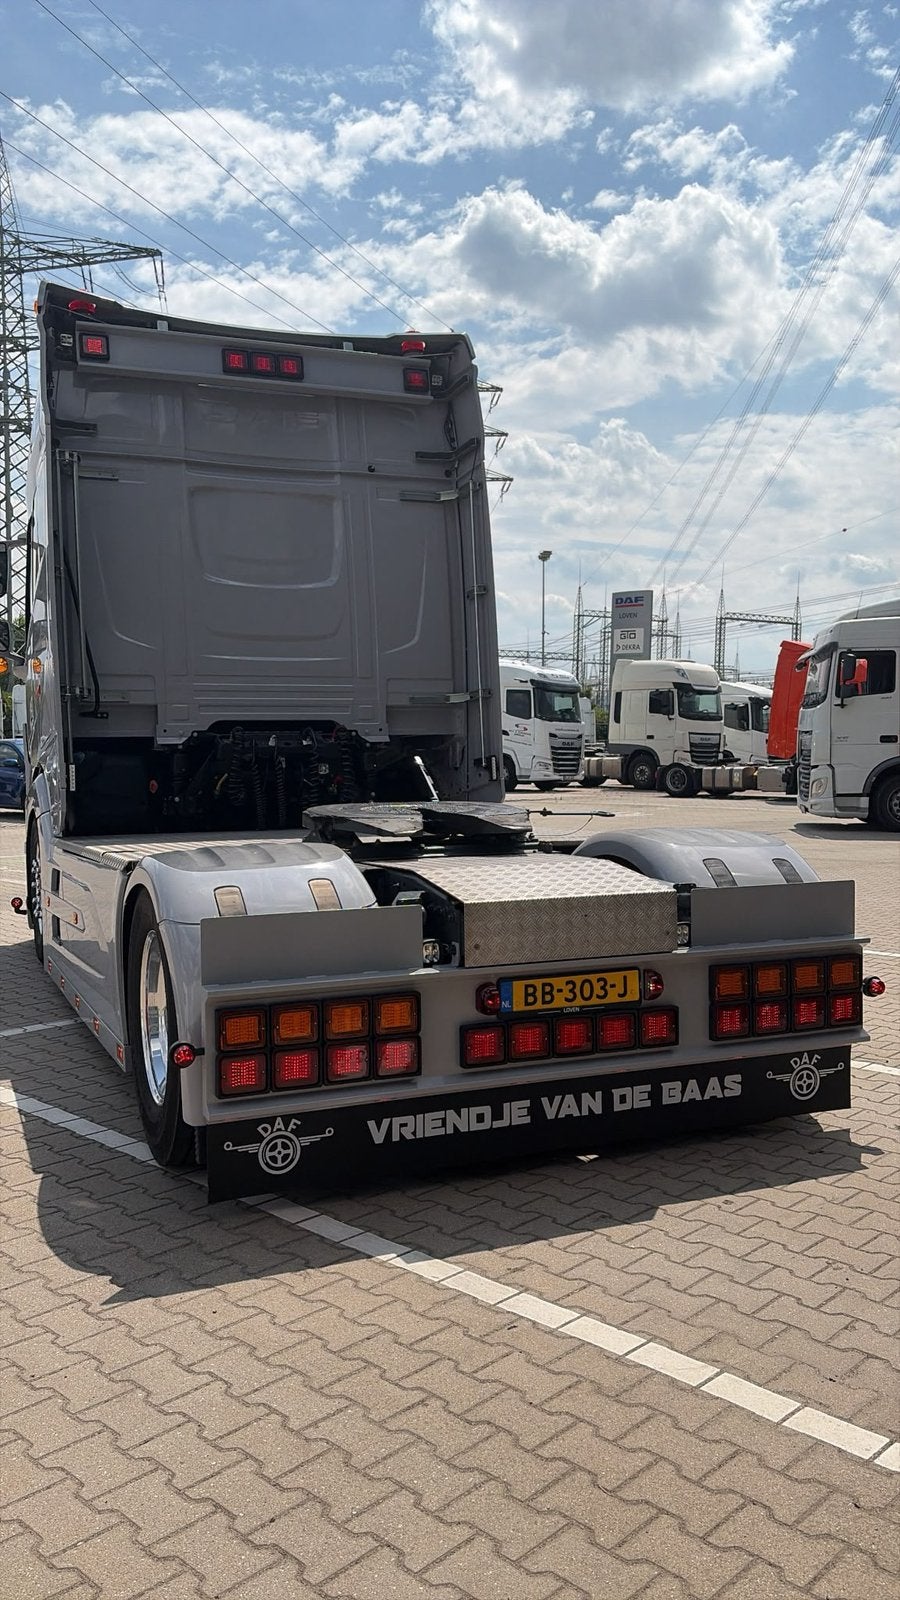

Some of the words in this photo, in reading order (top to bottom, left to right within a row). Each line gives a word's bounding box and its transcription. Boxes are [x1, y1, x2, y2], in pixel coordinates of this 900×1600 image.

[615, 596, 644, 604] DAF
[524, 975, 628, 1007] BB-303-J
[502, 1000, 512, 1008] NL
[790, 1052, 821, 1069] DAF
[367, 1100, 532, 1144] VRIENDJE
[541, 1091, 602, 1120] VAN
[612, 1084, 652, 1112] DE
[661, 1074, 742, 1105] BAAS
[257, 1117, 301, 1138] DAF
